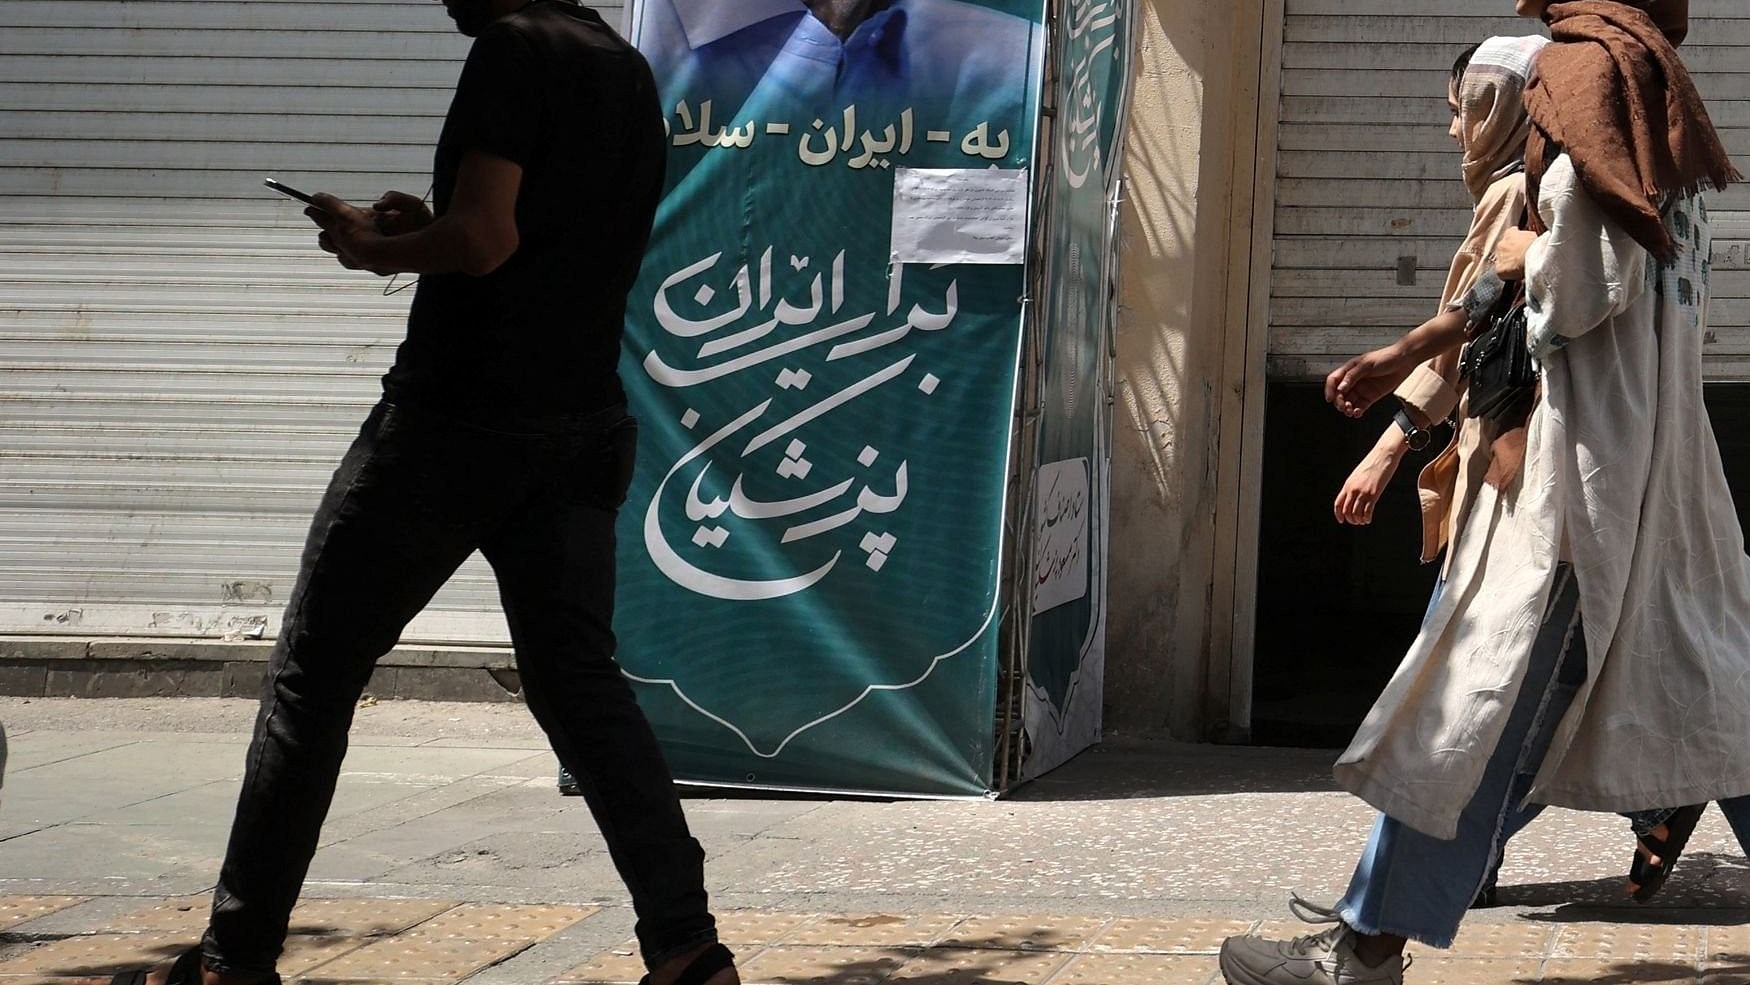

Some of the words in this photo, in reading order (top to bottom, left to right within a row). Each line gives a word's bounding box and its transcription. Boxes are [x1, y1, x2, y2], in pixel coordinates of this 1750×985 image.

[663, 99, 755, 148] سلا
[798, 105, 913, 169] ایران
[962, 122, 1010, 171] به
[653, 245, 846, 358] ایران
[644, 354, 916, 601] پزشکیان
